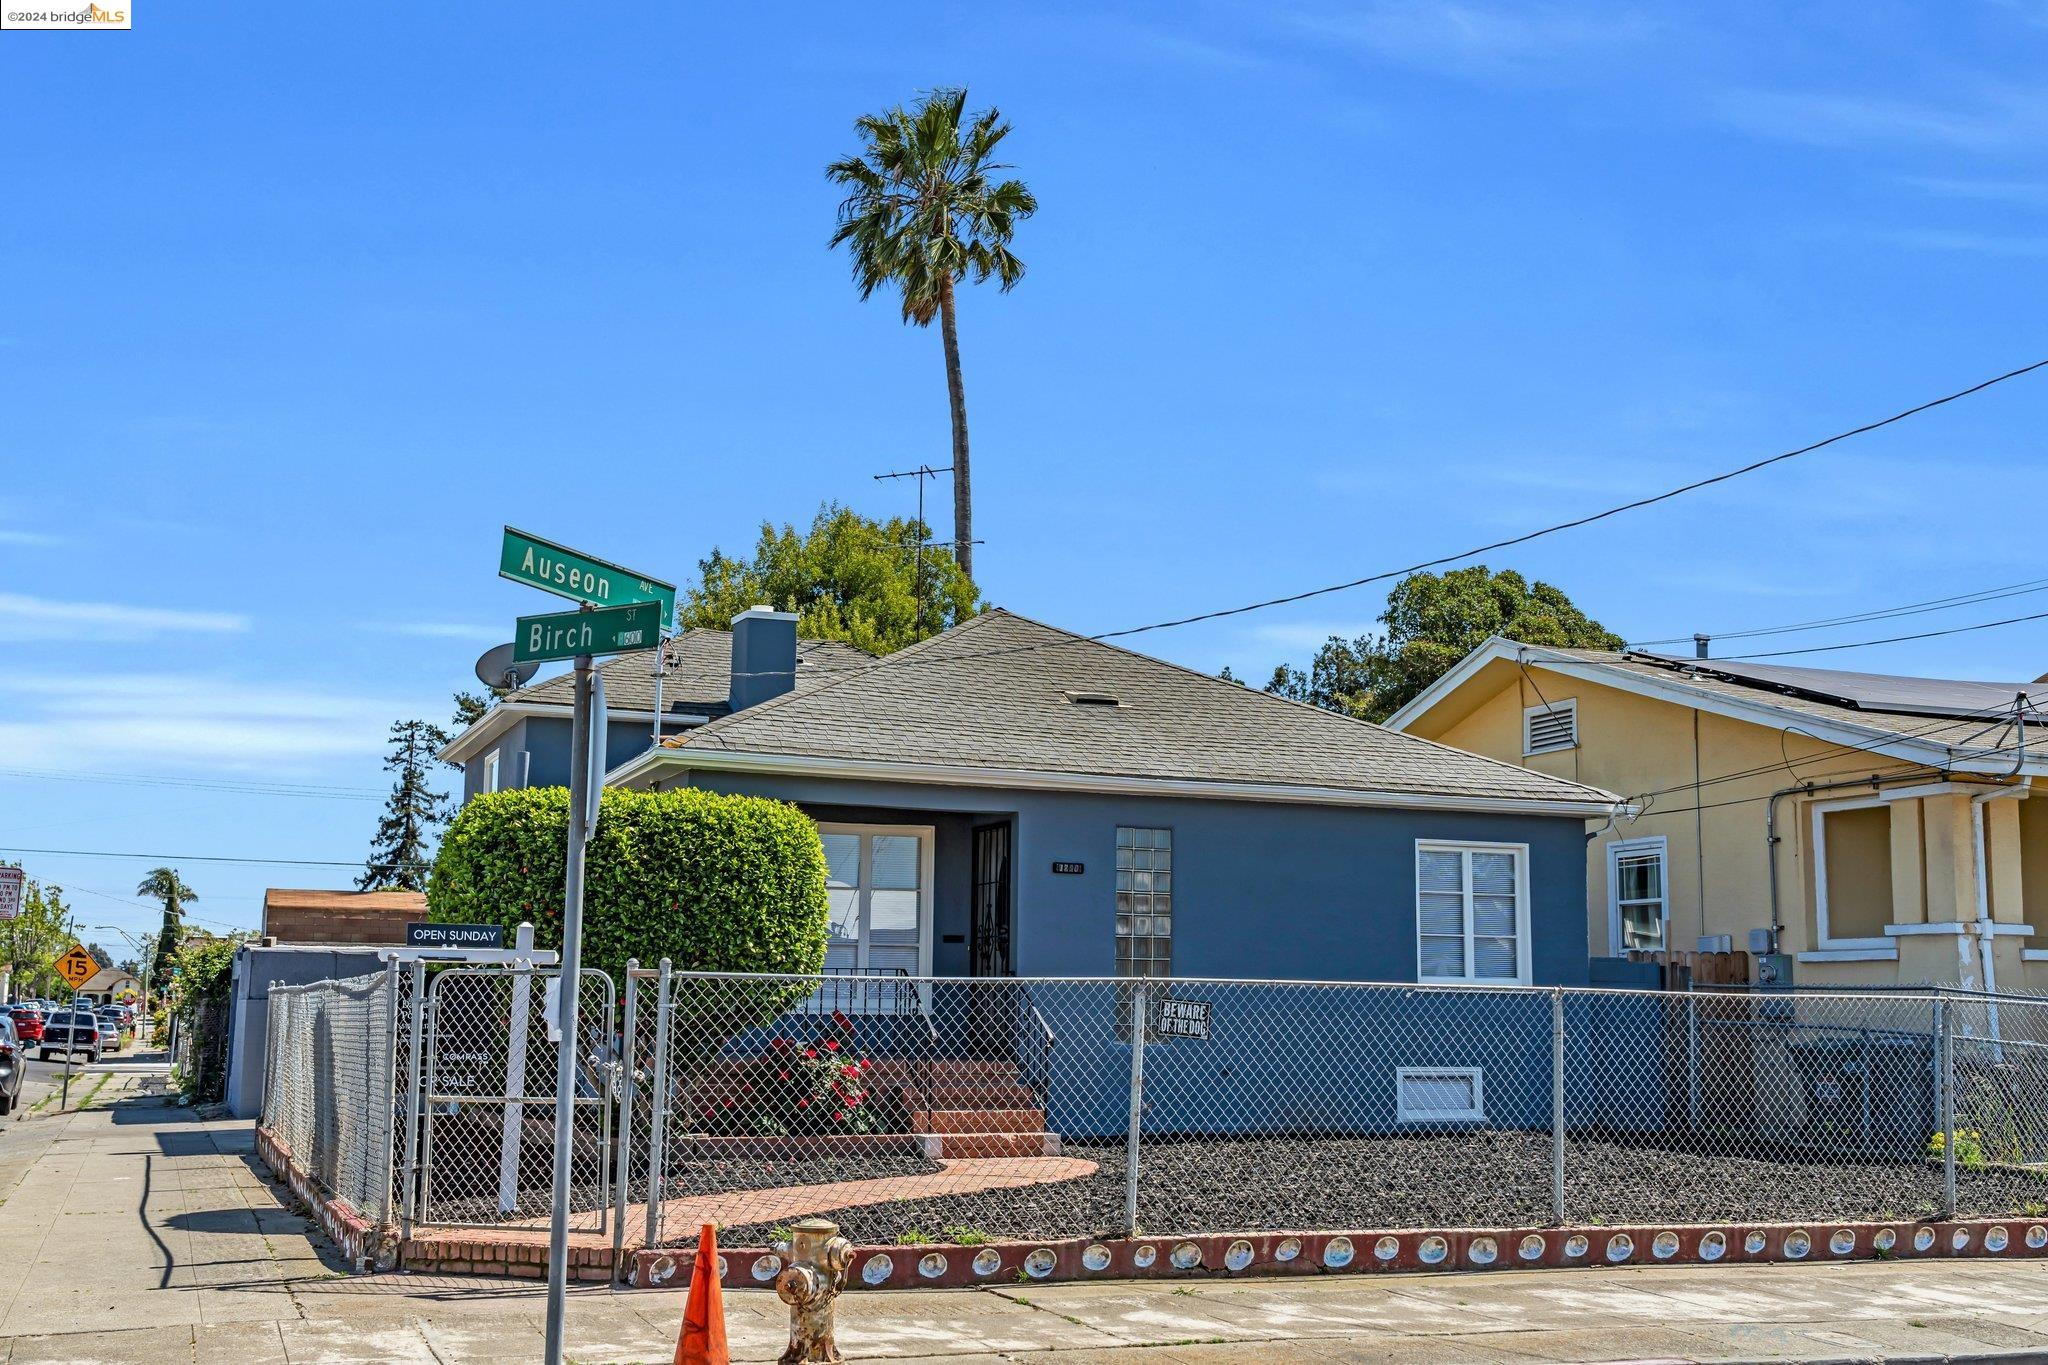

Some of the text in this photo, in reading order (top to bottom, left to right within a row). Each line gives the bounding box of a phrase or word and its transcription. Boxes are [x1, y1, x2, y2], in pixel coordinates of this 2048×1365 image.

[521, 546, 653, 599] Auseon AVE
[529, 609, 637, 652] Birch ST
[414, 929, 497, 941] OPEN SUNDAY
[66, 959, 88, 976] 15
[1163, 1002, 1207, 1020] BEWARE
[1161, 1017, 1206, 1035] OF THE DOG
[442, 1075, 475, 1087] SALE
